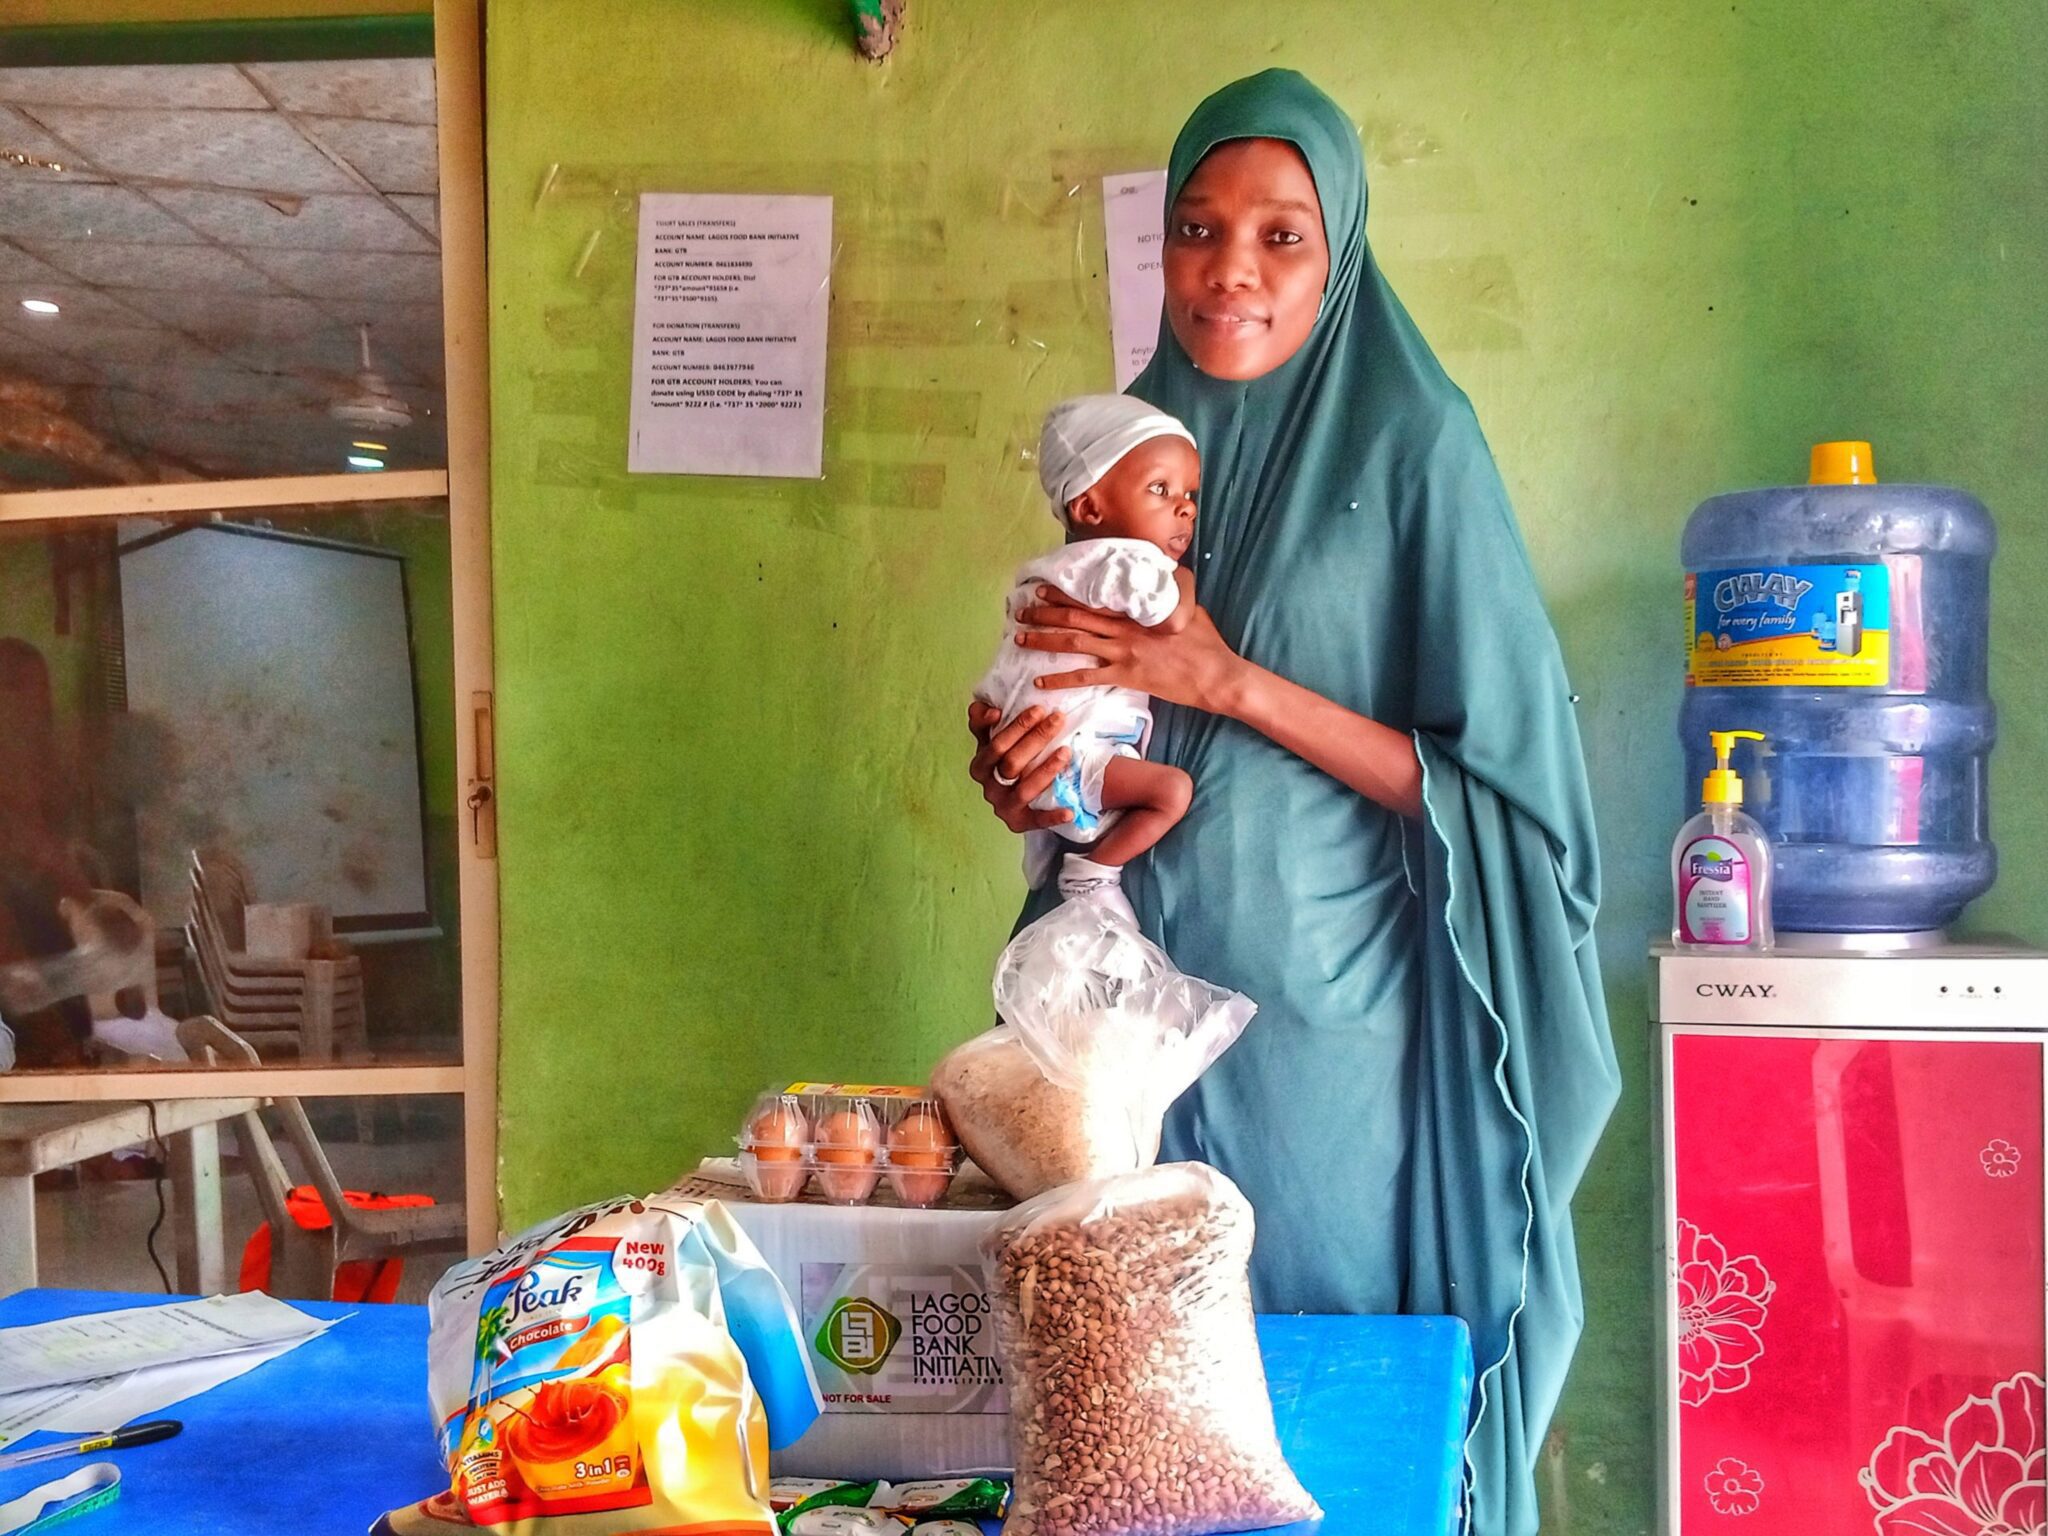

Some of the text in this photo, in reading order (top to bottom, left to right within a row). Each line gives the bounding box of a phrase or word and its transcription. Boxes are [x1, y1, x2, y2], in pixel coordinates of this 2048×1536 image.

[675, 390, 695, 398] using
[737, 390, 747, 398] by
[747, 390, 772, 398] dialing
[1713, 572, 1813, 613] CWAY
[1717, 611, 1796, 631] for every family
[1692, 861, 1731, 875] Fressia
[1696, 984, 1774, 998] CWAY
[625, 1241, 665, 1256] New
[622, 1257, 666, 1277] 400g
[504, 1270, 583, 1324] Peak
[911, 1292, 991, 1314] LAGOS
[912, 1314, 982, 1335] FOOD
[509, 1320, 573, 1350] Chocolate
[913, 1335, 976, 1356] BANK
[822, 1394, 892, 1403] NOT FOR SALE
[575, 1462, 587, 1478] 3
[588, 1464, 603, 1477] in
[602, 1457, 612, 1474] 1
[487, 1478, 507, 1491] ADD
